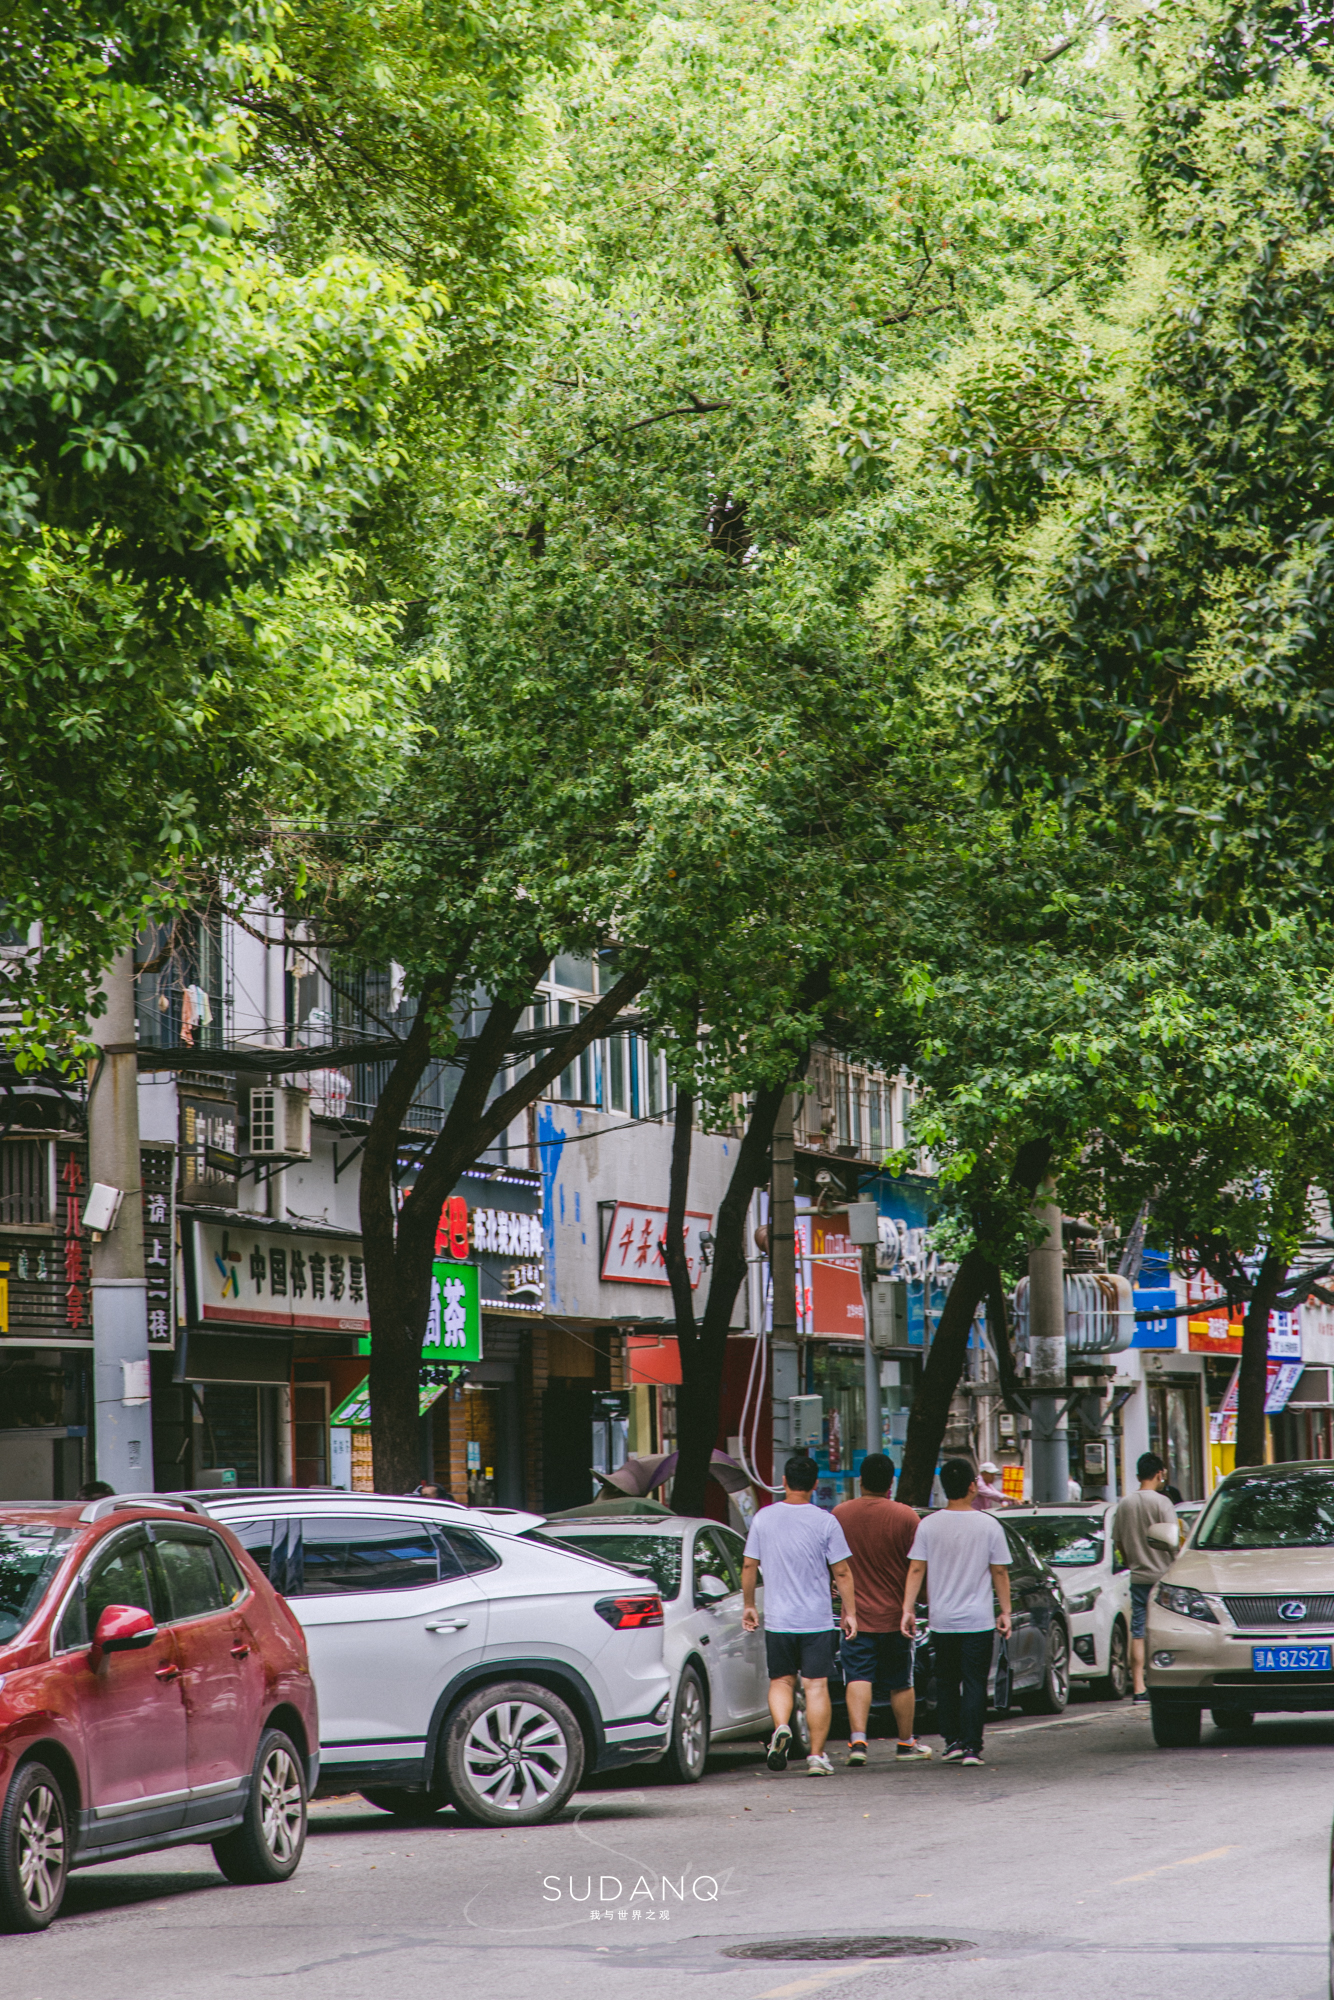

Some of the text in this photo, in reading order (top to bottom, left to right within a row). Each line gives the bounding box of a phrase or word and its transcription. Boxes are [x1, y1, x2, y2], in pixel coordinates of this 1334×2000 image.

[147, 1194, 168, 1339] 请上二楼
[249, 1243, 364, 1305] 中国体育彩票
